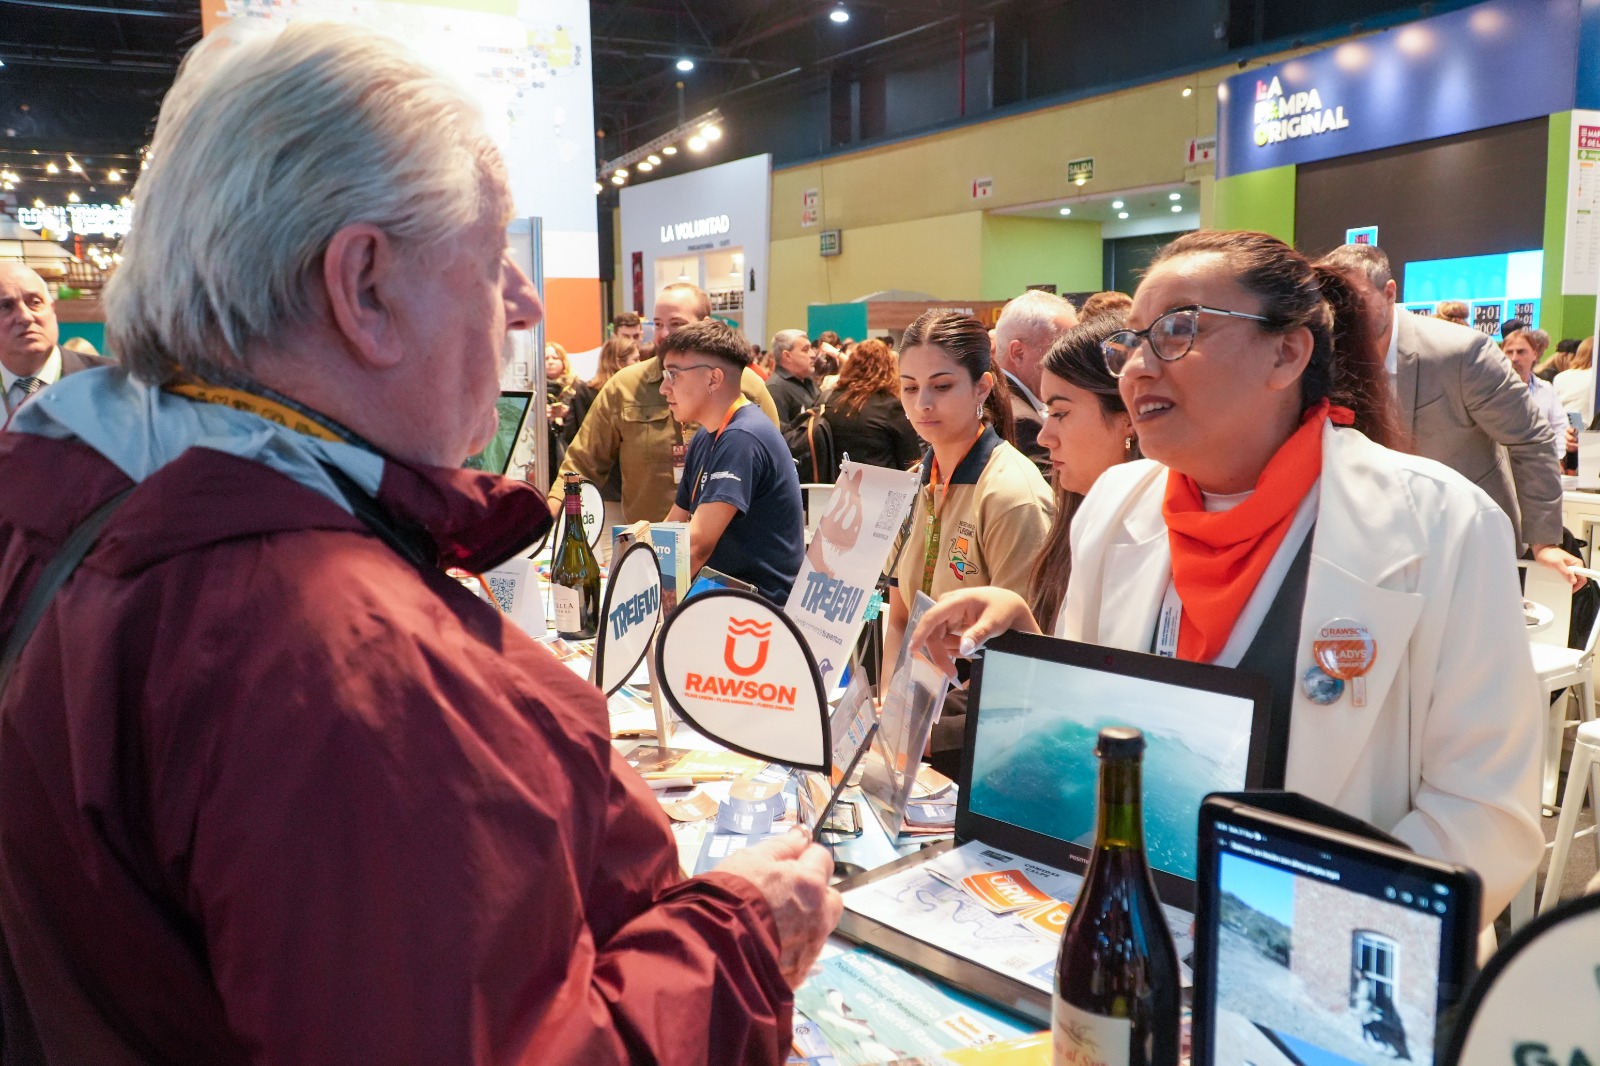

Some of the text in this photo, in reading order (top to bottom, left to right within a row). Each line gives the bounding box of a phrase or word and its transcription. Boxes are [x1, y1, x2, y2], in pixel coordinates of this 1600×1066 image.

[1256, 76, 1283, 100] LA
[1254, 89, 1322, 124] PAMPA
[1254, 106, 1349, 146] ORIGINAL
[1069, 162, 1092, 174] SALIDA
[660, 214, 730, 243] LA VOLUNTAD
[609, 583, 659, 641] TRELEW
[801, 570, 865, 625] TRELEW
[1329, 627, 1368, 636] RAWSON
[1329, 649, 1367, 659] LADYS
[685, 672, 797, 705] RAWSON
[872, 1002, 912, 1031] Puerto
